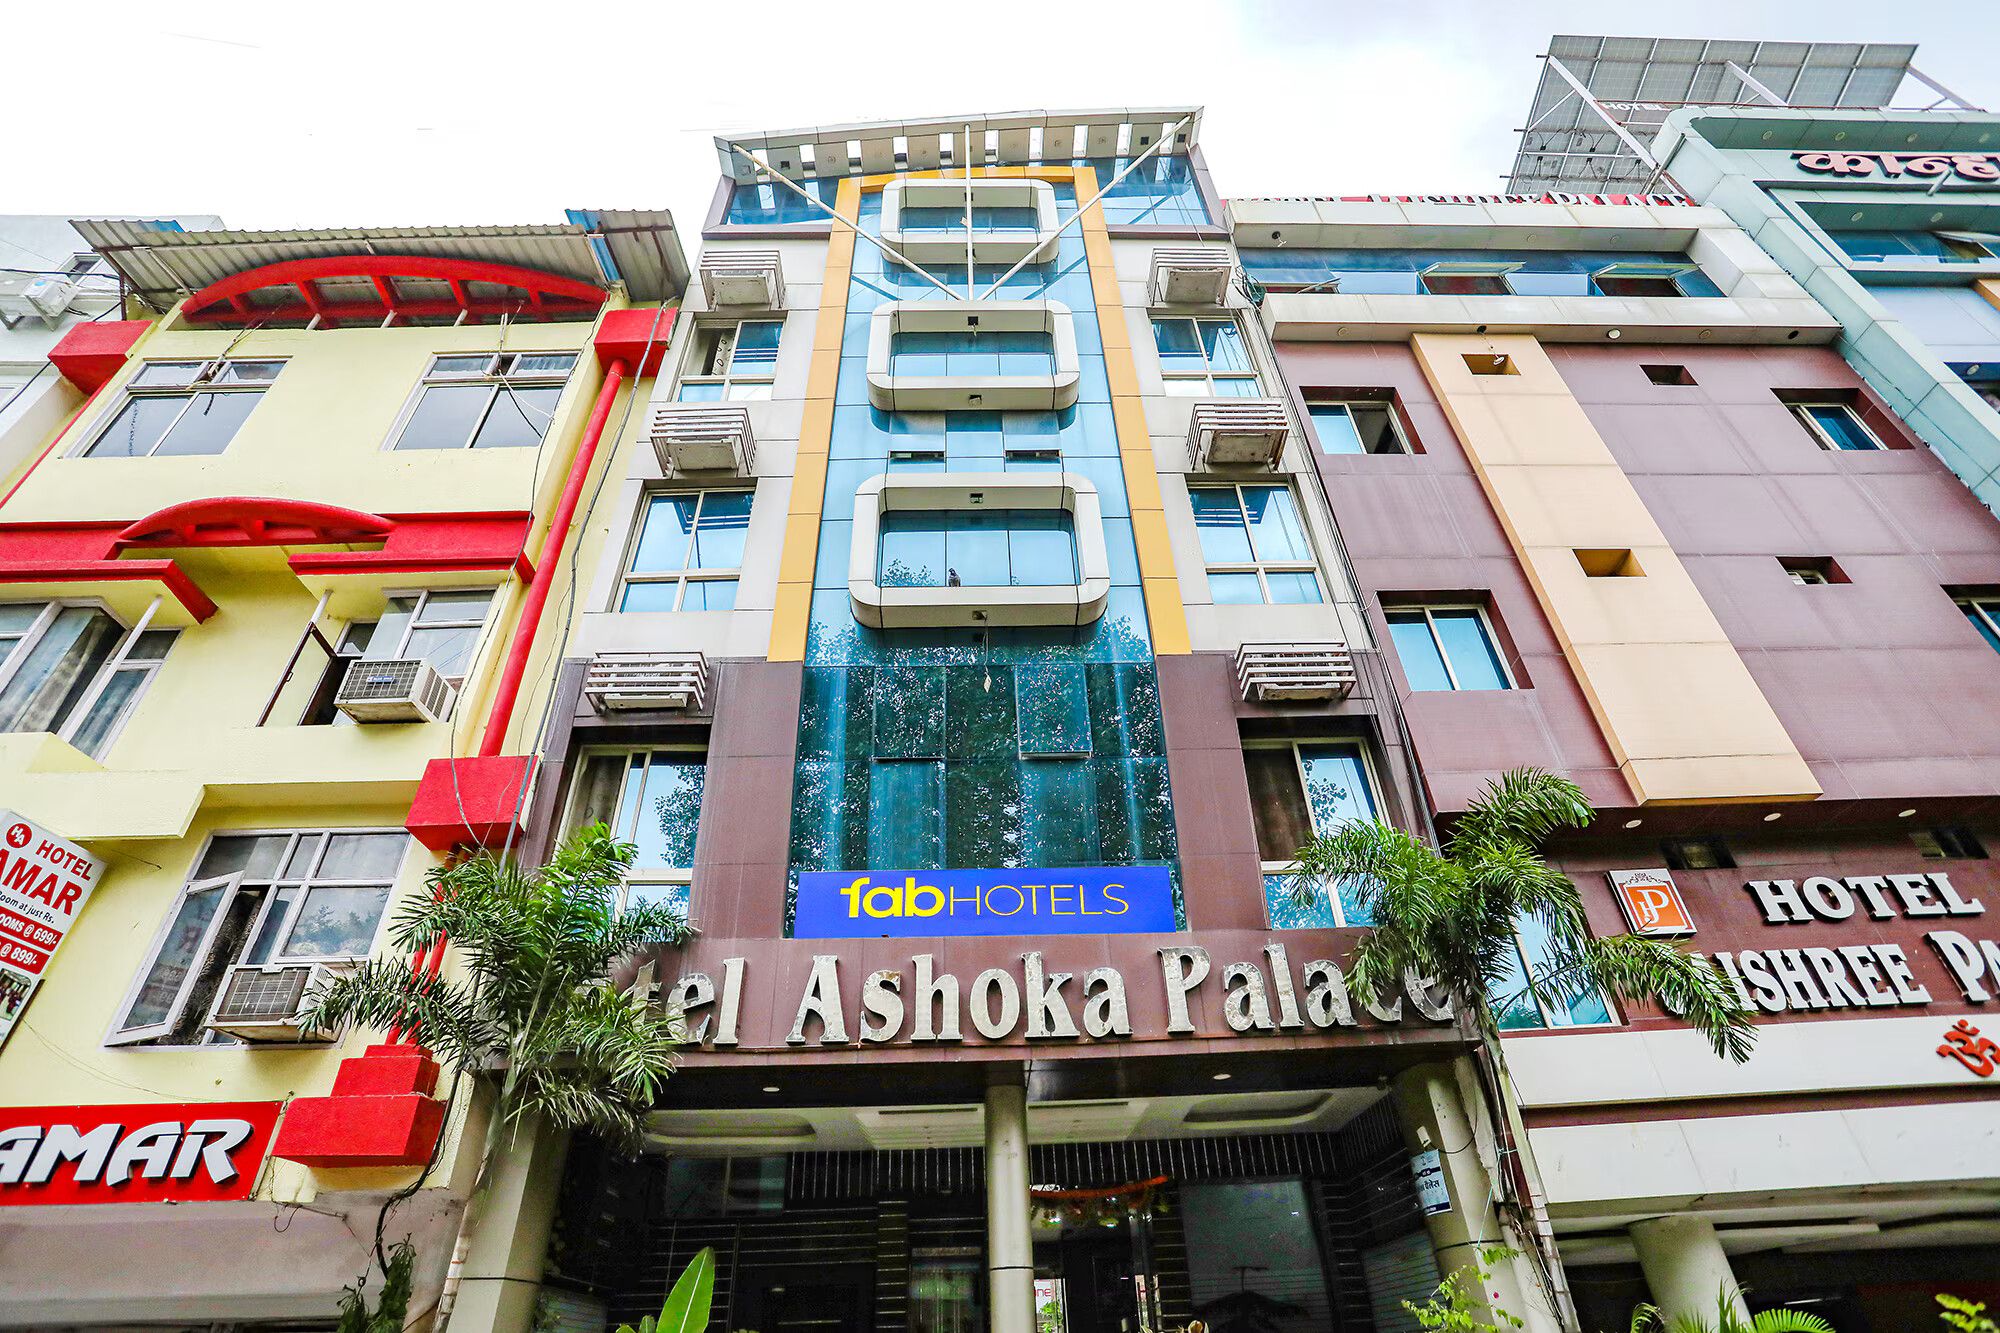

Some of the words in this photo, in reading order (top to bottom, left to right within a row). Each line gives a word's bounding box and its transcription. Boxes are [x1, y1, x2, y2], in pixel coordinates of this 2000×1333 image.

[35, 839, 93, 881] HOTEL
[0, 891, 18, 907] oom
[19, 902, 28, 911] at
[26, 905, 43, 918] just
[43, 912, 54, 924] Rs.
[1747, 872, 1986, 922] HOTEL
[572, 957, 745, 1046] tel
[786, 951, 1133, 1043] Ashoka
[1660, 944, 1933, 1015] ISHREE
